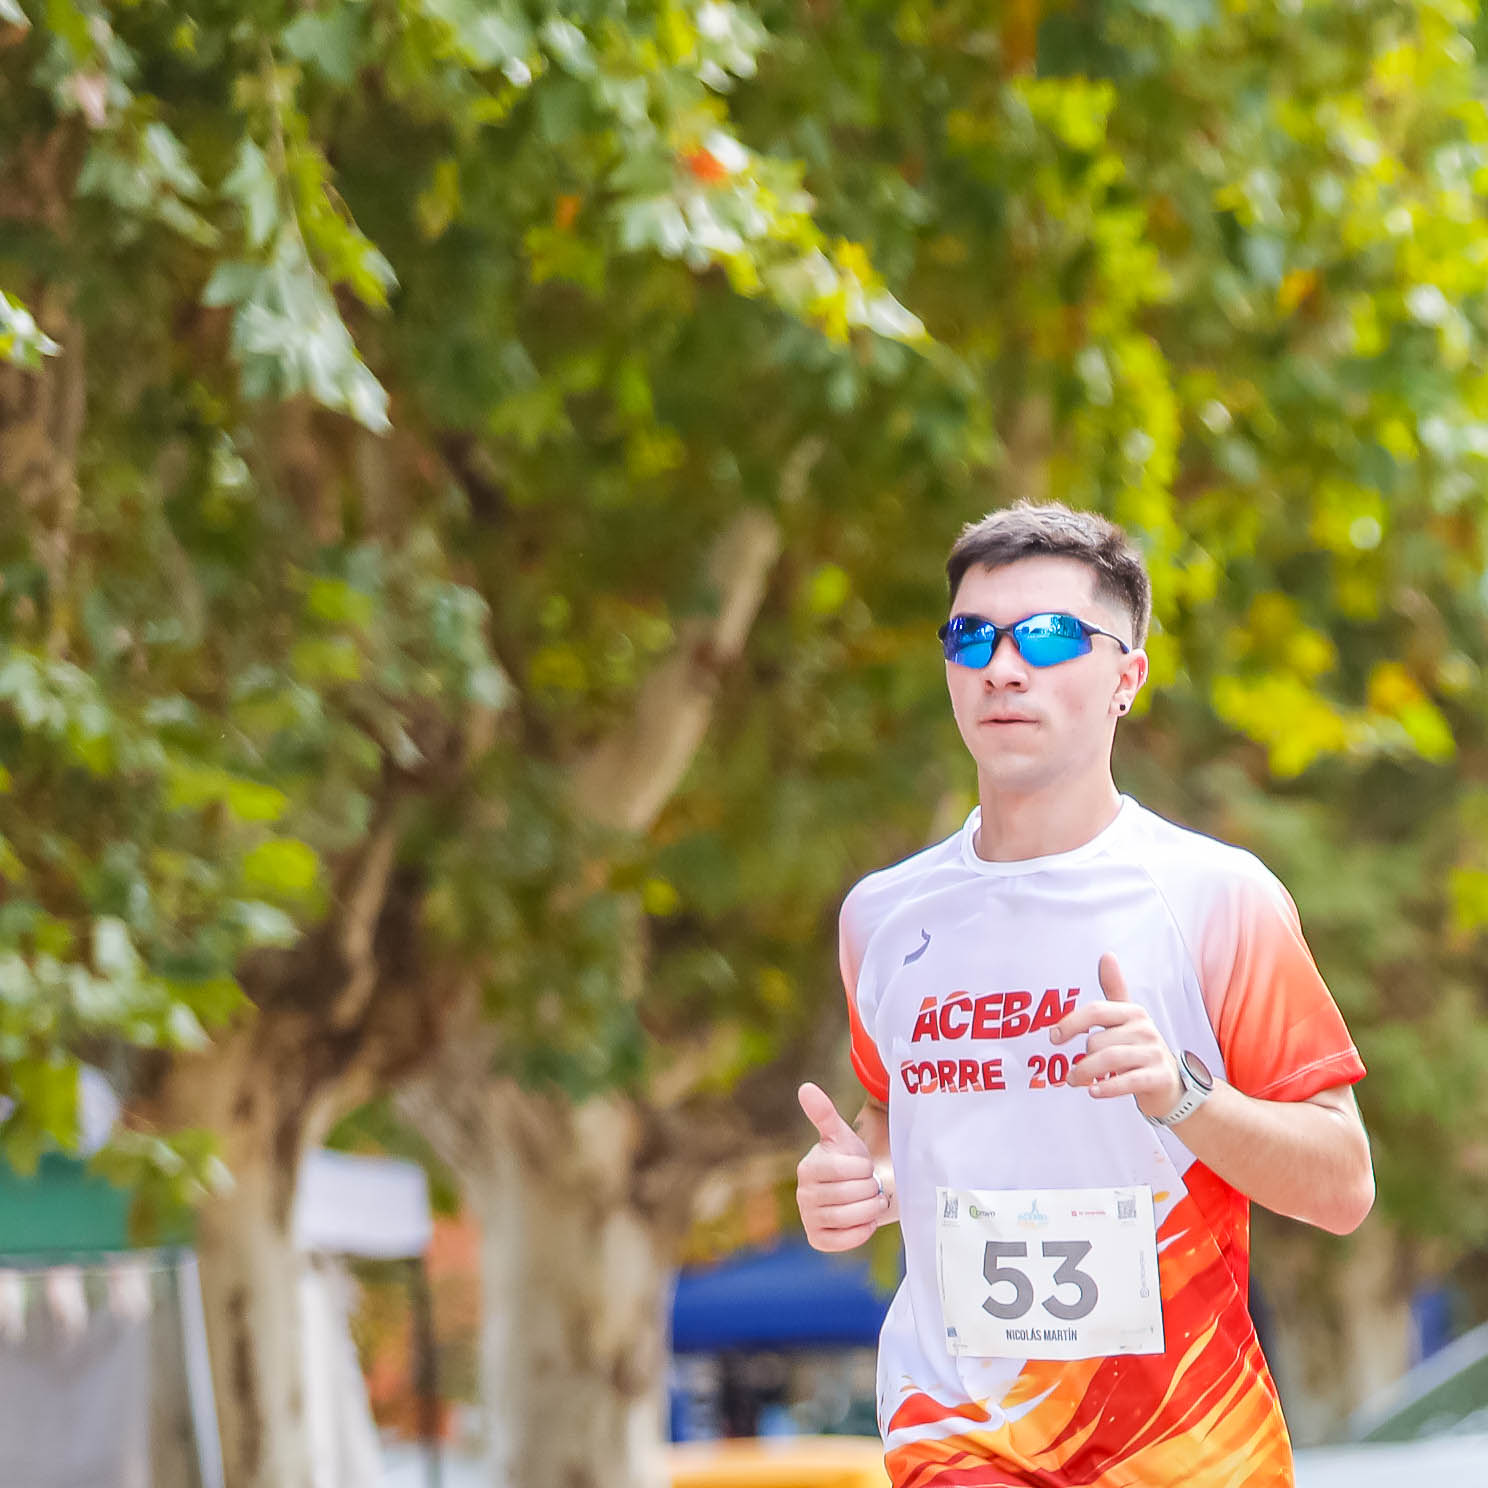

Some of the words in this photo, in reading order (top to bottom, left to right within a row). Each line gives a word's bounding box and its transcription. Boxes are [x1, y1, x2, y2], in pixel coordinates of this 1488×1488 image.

[900, 1057, 1006, 1095] CORRE
[1027, 1052, 1117, 1089] 20
[982, 1240, 1099, 1320] 53
[1006, 1327, 1042, 1341] NICOLÁS
[1043, 1327, 1078, 1341] MARTÍN
